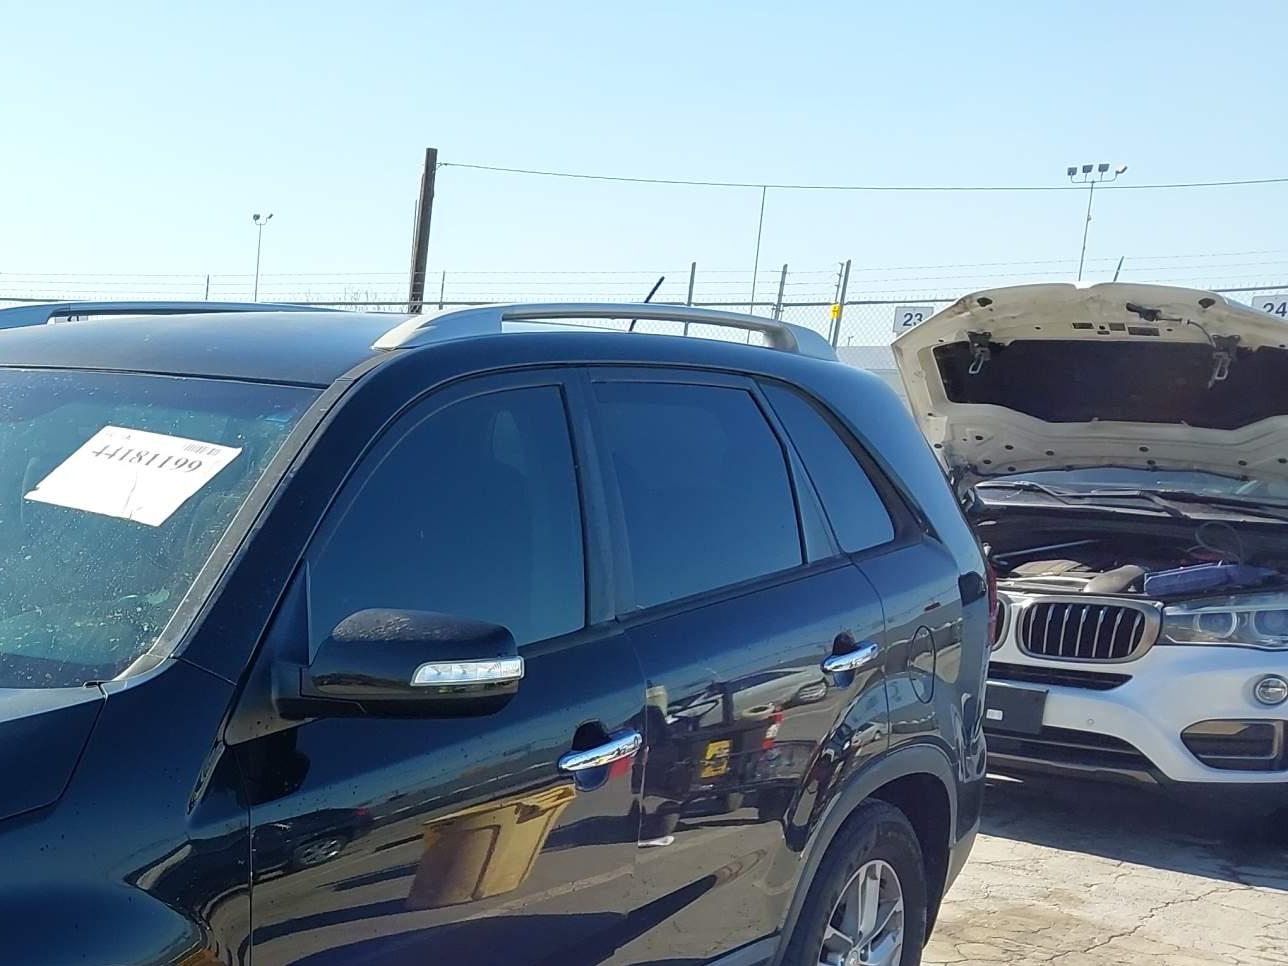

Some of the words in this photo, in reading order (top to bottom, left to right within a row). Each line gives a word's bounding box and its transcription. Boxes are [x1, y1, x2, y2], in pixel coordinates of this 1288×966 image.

[1263, 302, 1288, 317] 24
[902, 312, 924, 327] 23
[91, 444, 203, 473] 44181199
